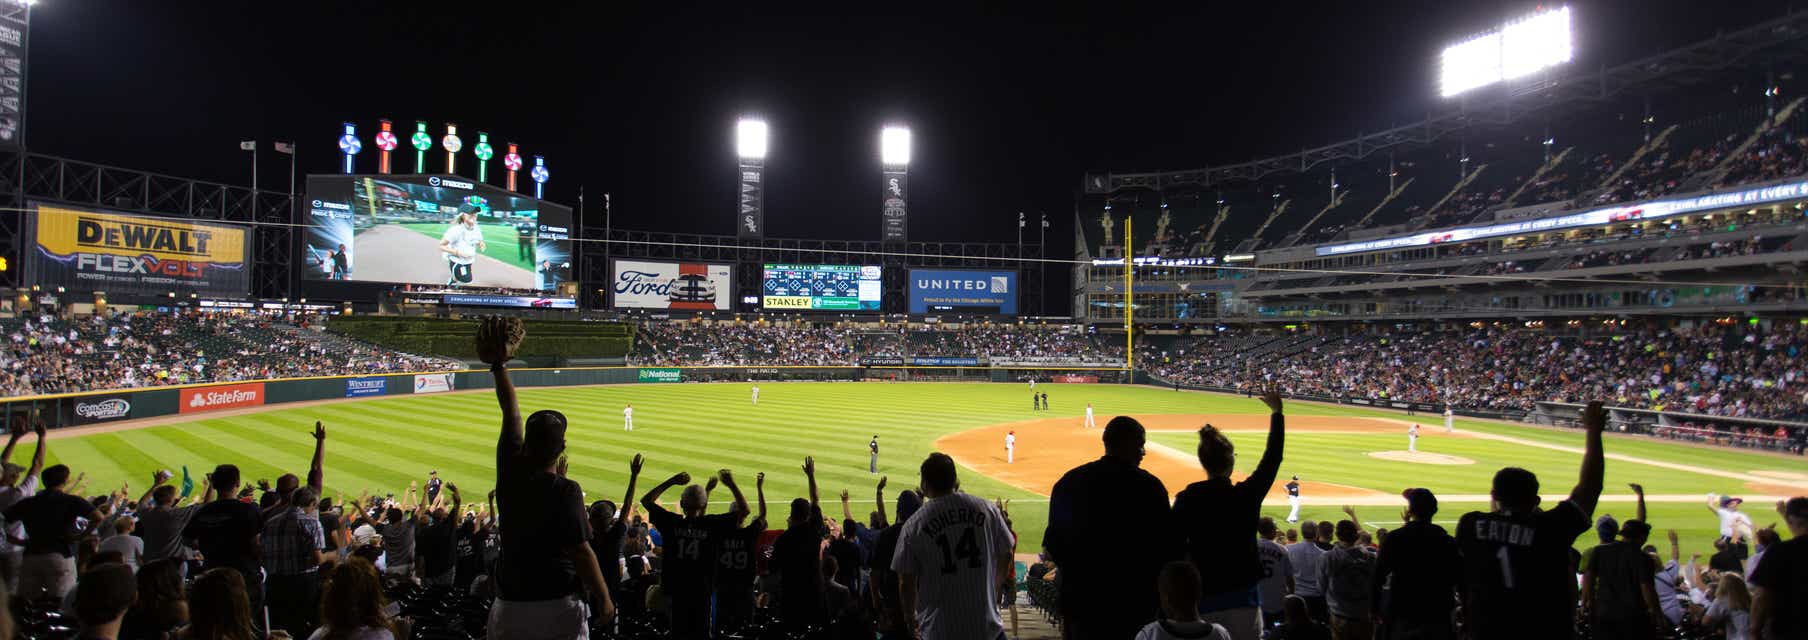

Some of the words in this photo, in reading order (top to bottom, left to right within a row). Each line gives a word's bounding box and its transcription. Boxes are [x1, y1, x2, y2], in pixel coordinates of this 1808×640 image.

[1761, 184, 1798, 200] EVERY
[77, 253, 209, 278] FLEXVOLT
[614, 270, 677, 296] Ford
[918, 279, 987, 290] UNITED
[766, 297, 809, 307] STANLEY
[648, 370, 680, 378] National
[1475, 518, 1536, 546] EATON
[676, 538, 701, 560] 14
[932, 527, 981, 574] 14
[719, 551, 748, 569] 49
